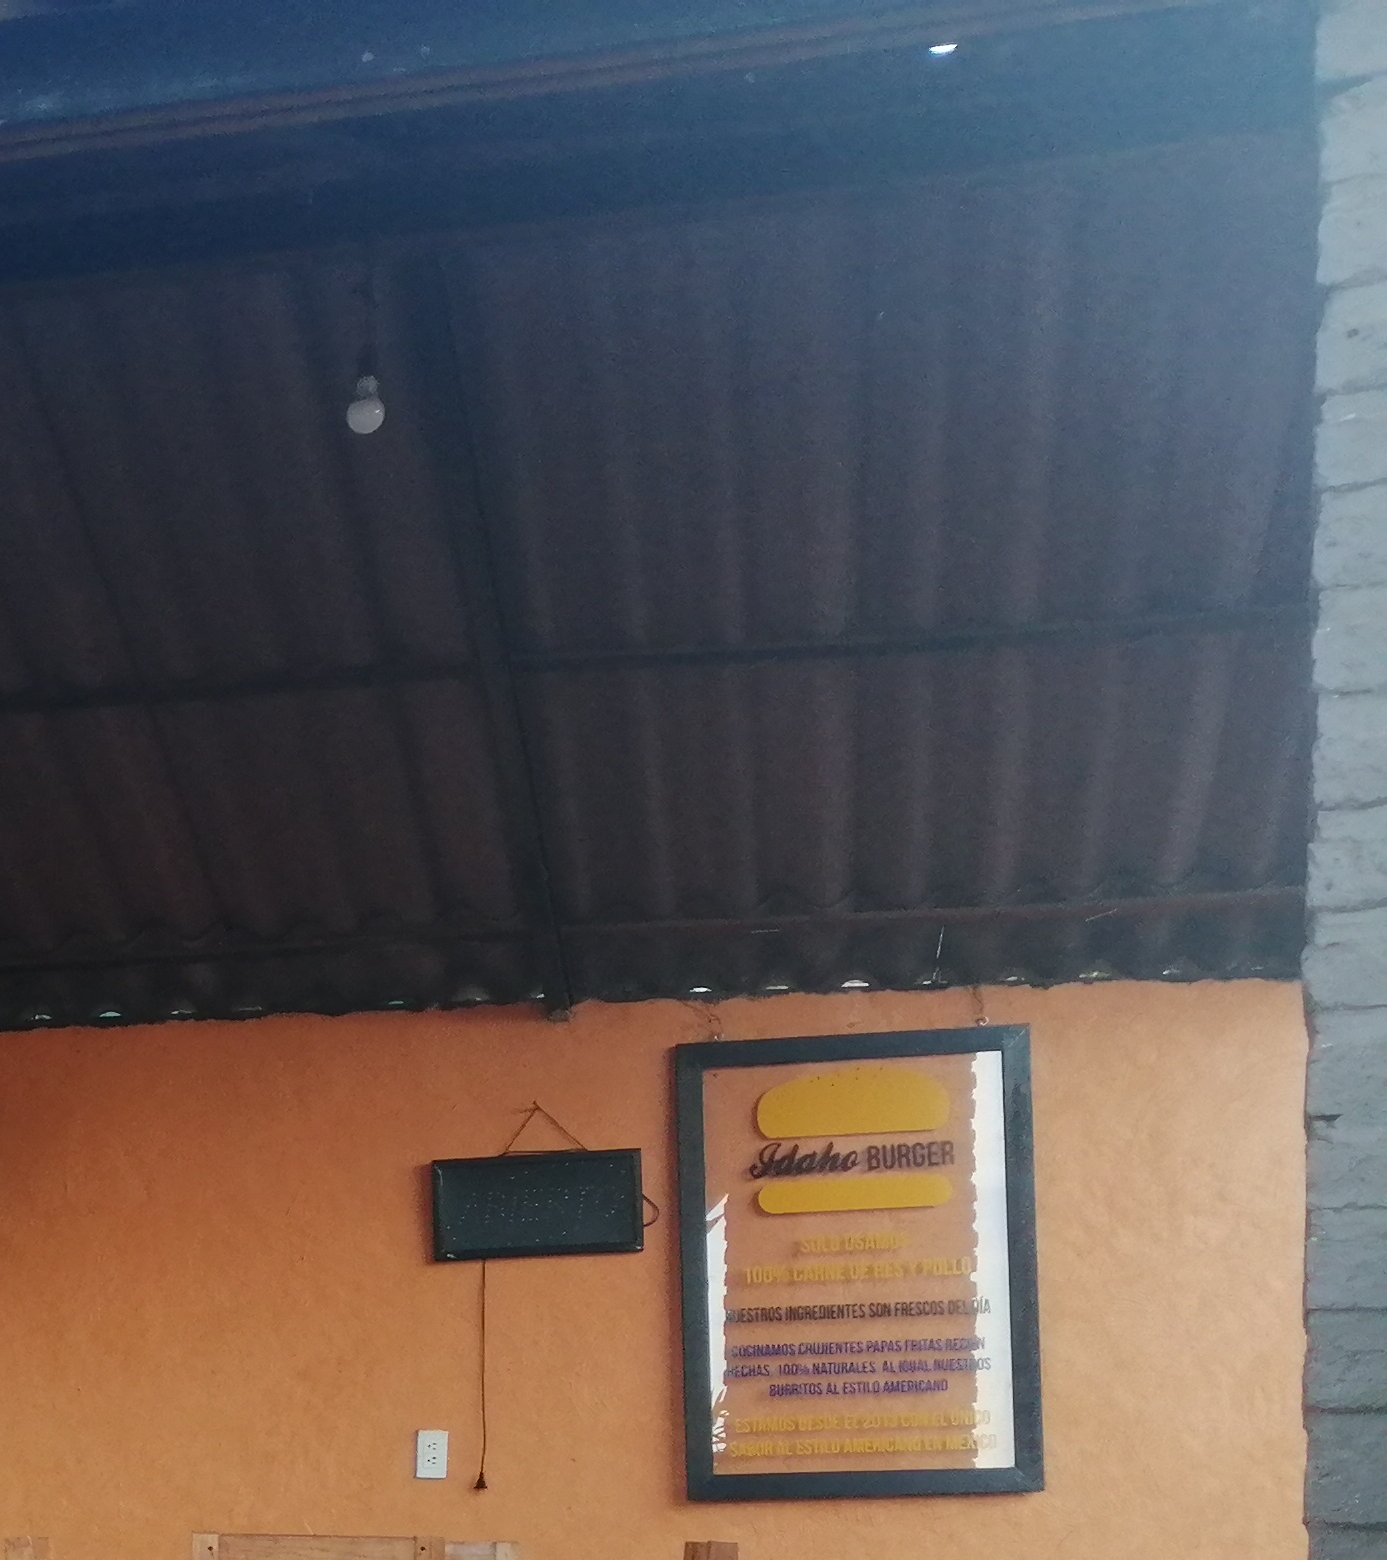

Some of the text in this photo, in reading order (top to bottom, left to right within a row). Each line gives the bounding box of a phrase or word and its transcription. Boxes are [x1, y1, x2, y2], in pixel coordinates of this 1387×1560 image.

[749, 1140, 955, 1179] Idaho BURGER
[793, 1262, 845, 1281] CARNE
[874, 1260, 904, 1278] RES
[922, 1256, 973, 1275] POLLO
[785, 1303, 866, 1321] INGREDIENTES
[868, 1302, 891, 1318] SON
[894, 1300, 945, 1317] FRESCOS
[947, 1299, 970, 1315] DEL
[731, 1343, 795, 1358] COCINAMOS
[797, 1341, 864, 1355] CRUJIENTES
[867, 1340, 902, 1352] PAPAS
[905, 1338, 943, 1351] FRITAS
[882, 1360, 896, 1373] AL
[933, 1357, 991, 1371] NUESTROS
[769, 1378, 949, 1397] BURRITOS AL ESTILO AMERICANO
